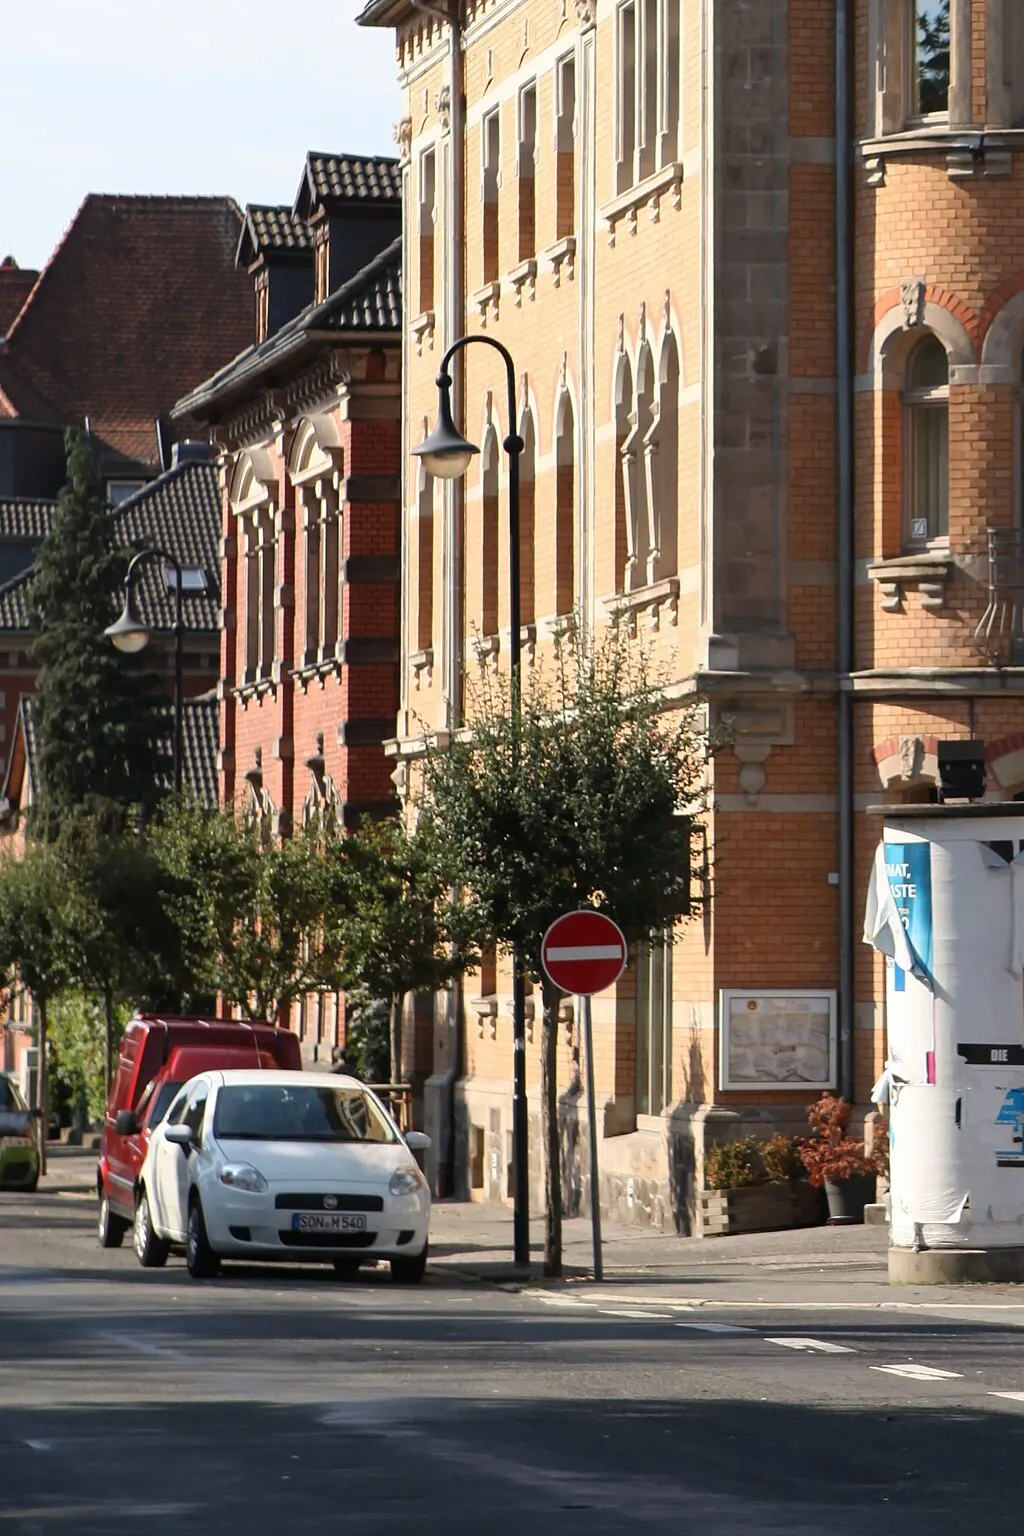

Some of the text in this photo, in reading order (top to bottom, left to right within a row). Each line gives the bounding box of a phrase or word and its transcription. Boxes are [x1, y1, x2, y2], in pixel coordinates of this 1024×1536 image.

[990, 1049, 1008, 1062] DIE
[300, 1215, 324, 1228] SON
[342, 1216, 364, 1229] 540
